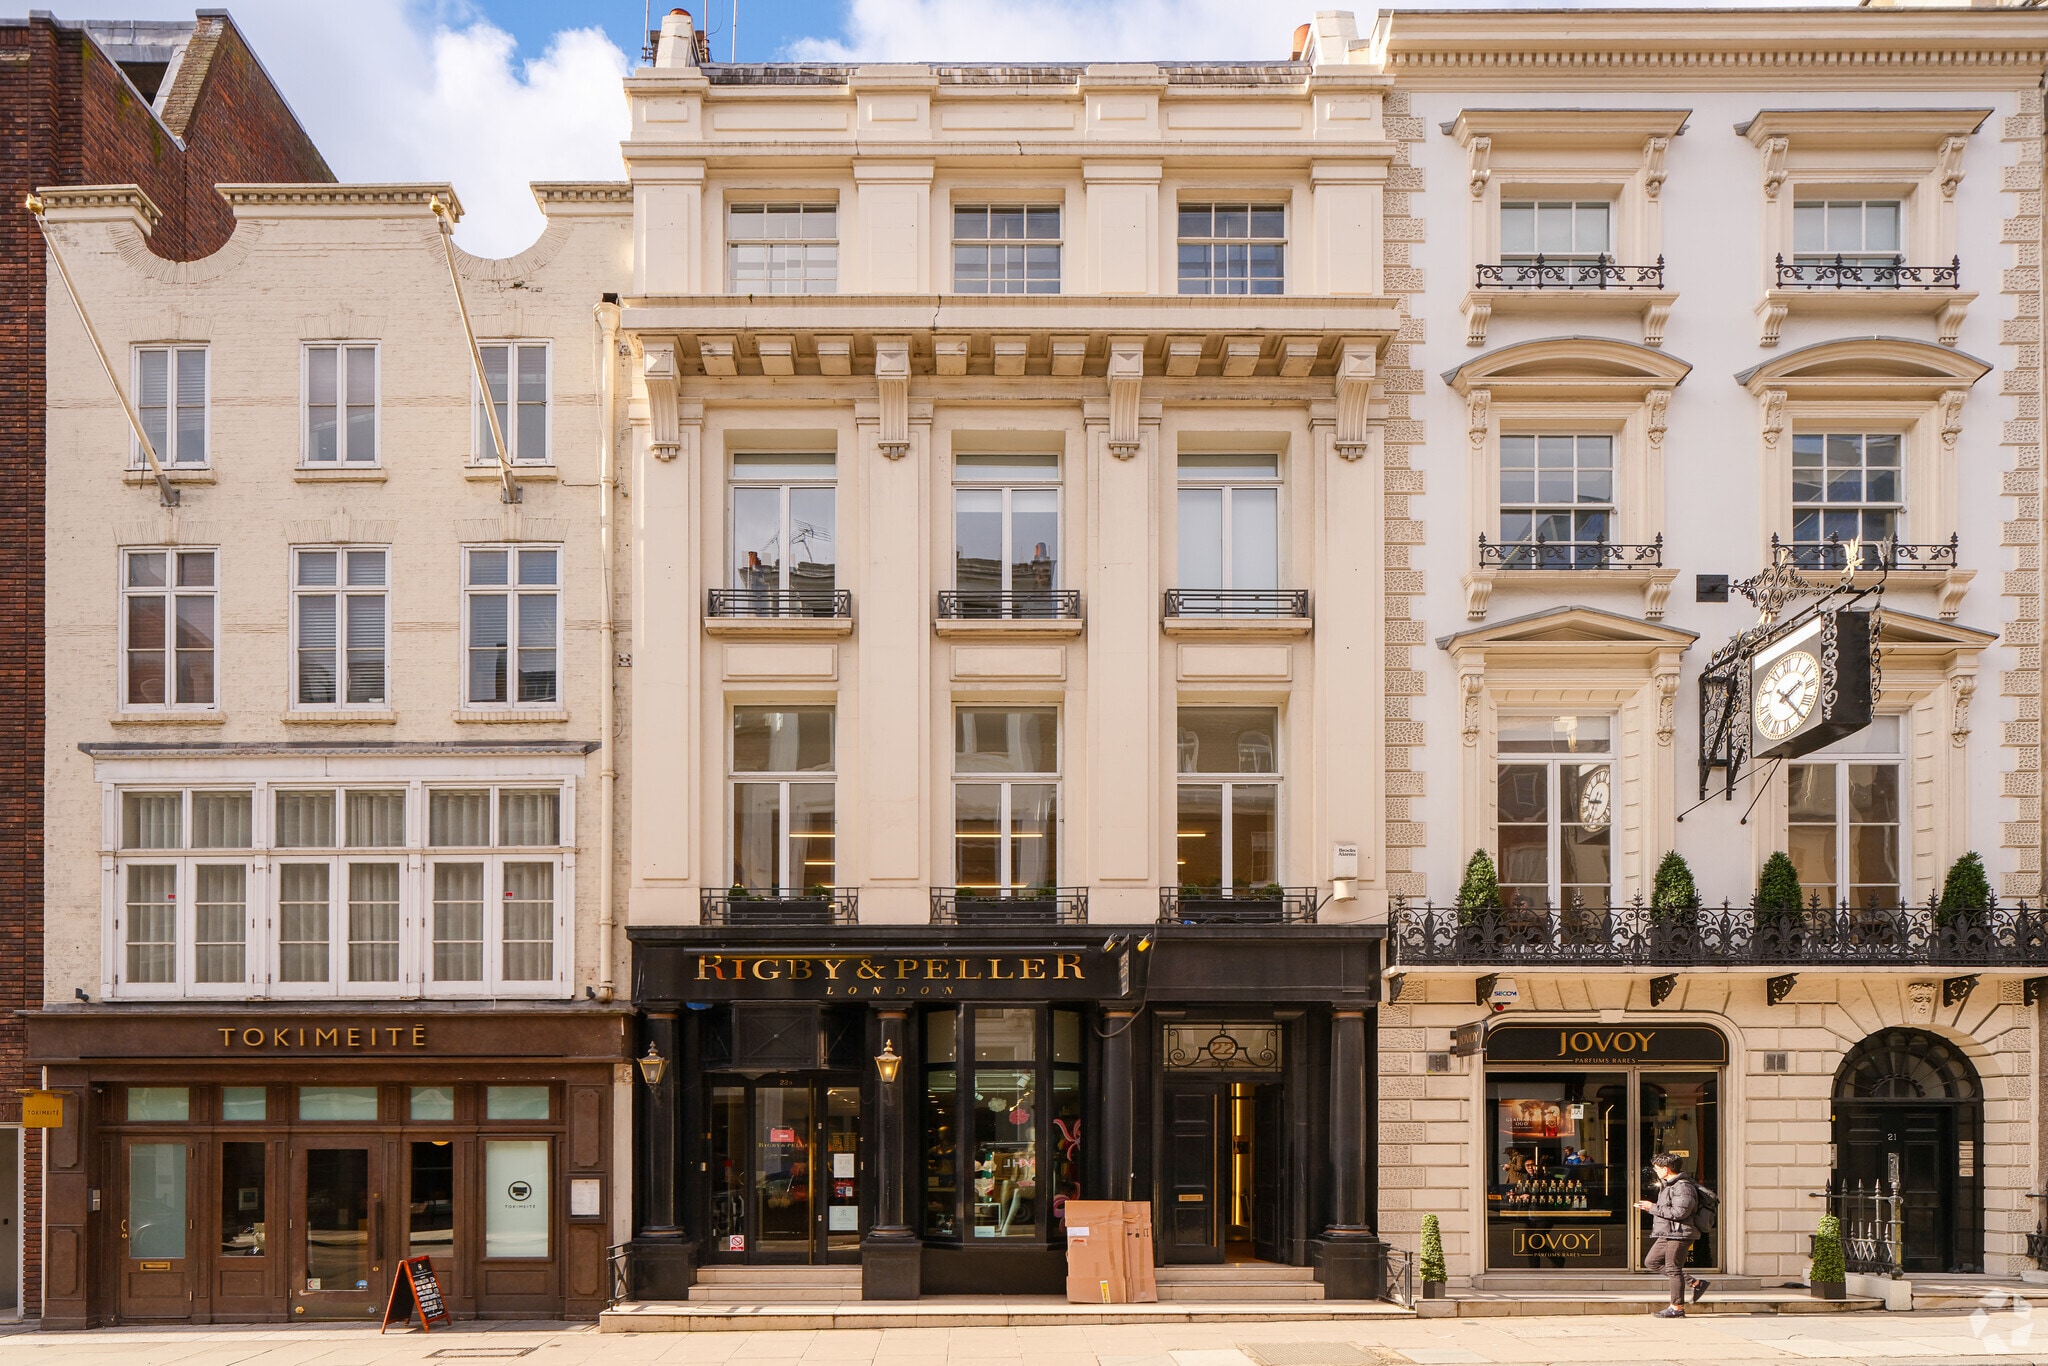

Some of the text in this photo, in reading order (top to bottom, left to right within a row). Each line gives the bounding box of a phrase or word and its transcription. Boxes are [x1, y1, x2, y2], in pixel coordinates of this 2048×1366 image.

[693, 952, 1086, 980] RIGBY & PELLER
[826, 986, 954, 995] LONDON
[1212, 1041, 1235, 1055] 22
[1557, 1031, 1656, 1057] JOVOY
[1887, 1133, 1897, 1141] 21
[1519, 1233, 1595, 1253] JOVOY
